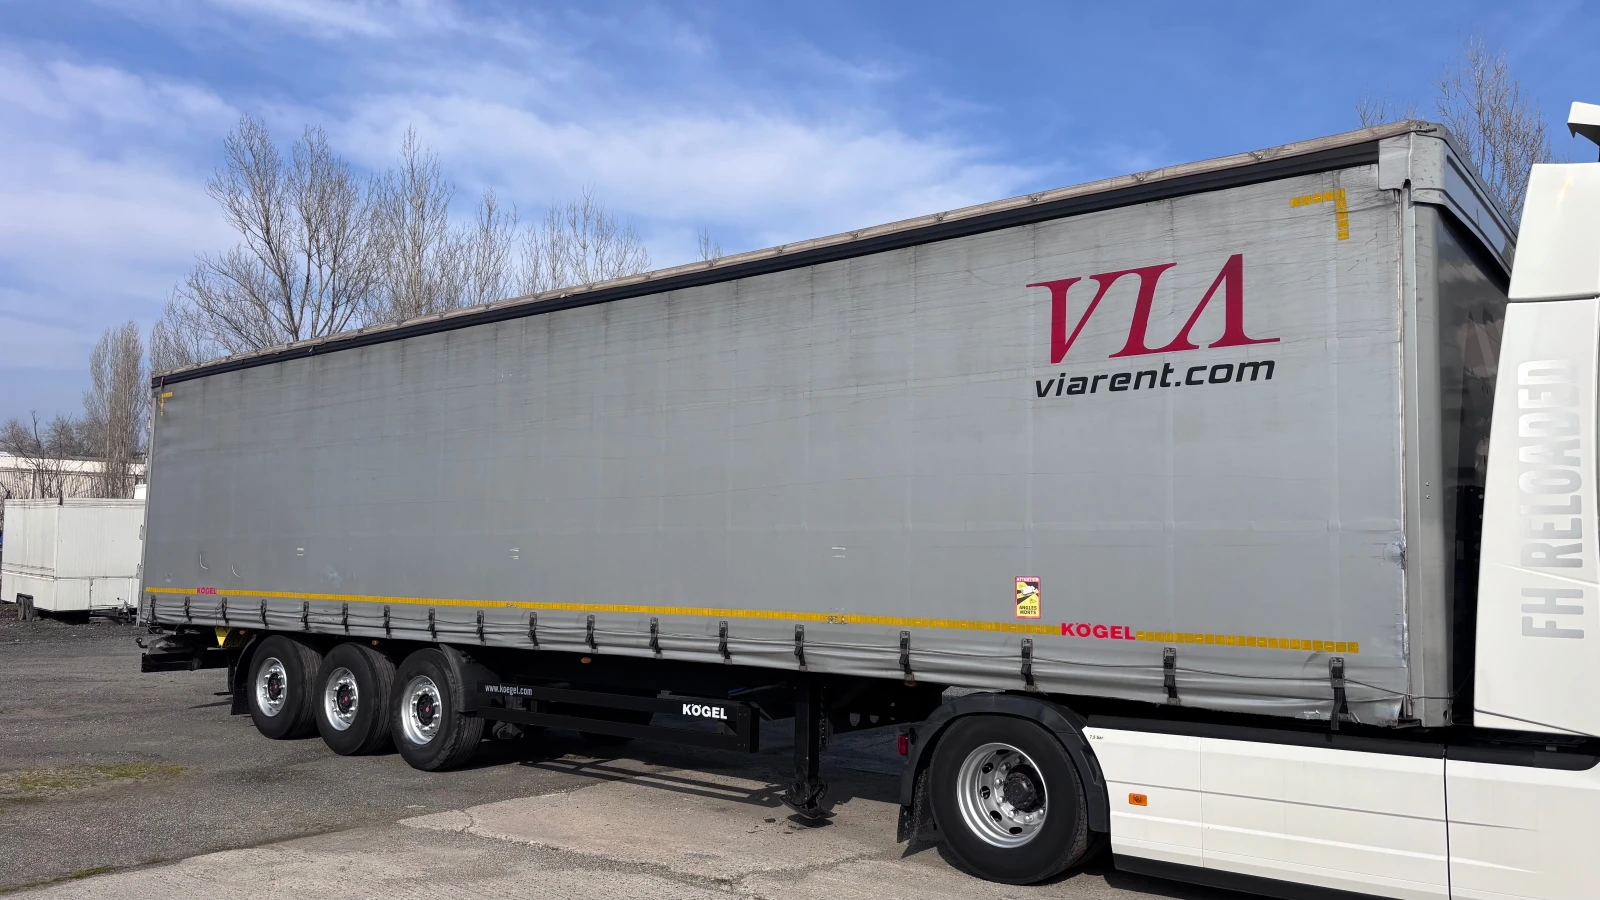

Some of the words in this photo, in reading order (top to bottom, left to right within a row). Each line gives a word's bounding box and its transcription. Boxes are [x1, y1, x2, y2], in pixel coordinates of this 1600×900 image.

[1026, 253, 1280, 364] VIA
[1035, 360, 1276, 398] viarent.com
[1517, 359, 1583, 569] RELOADED
[1061, 622, 1136, 640] KÖGEL
[1521, 587, 1585, 639] FH
[484, 684, 533, 696] www.koegel.com
[682, 703, 728, 719] KÖGEL
